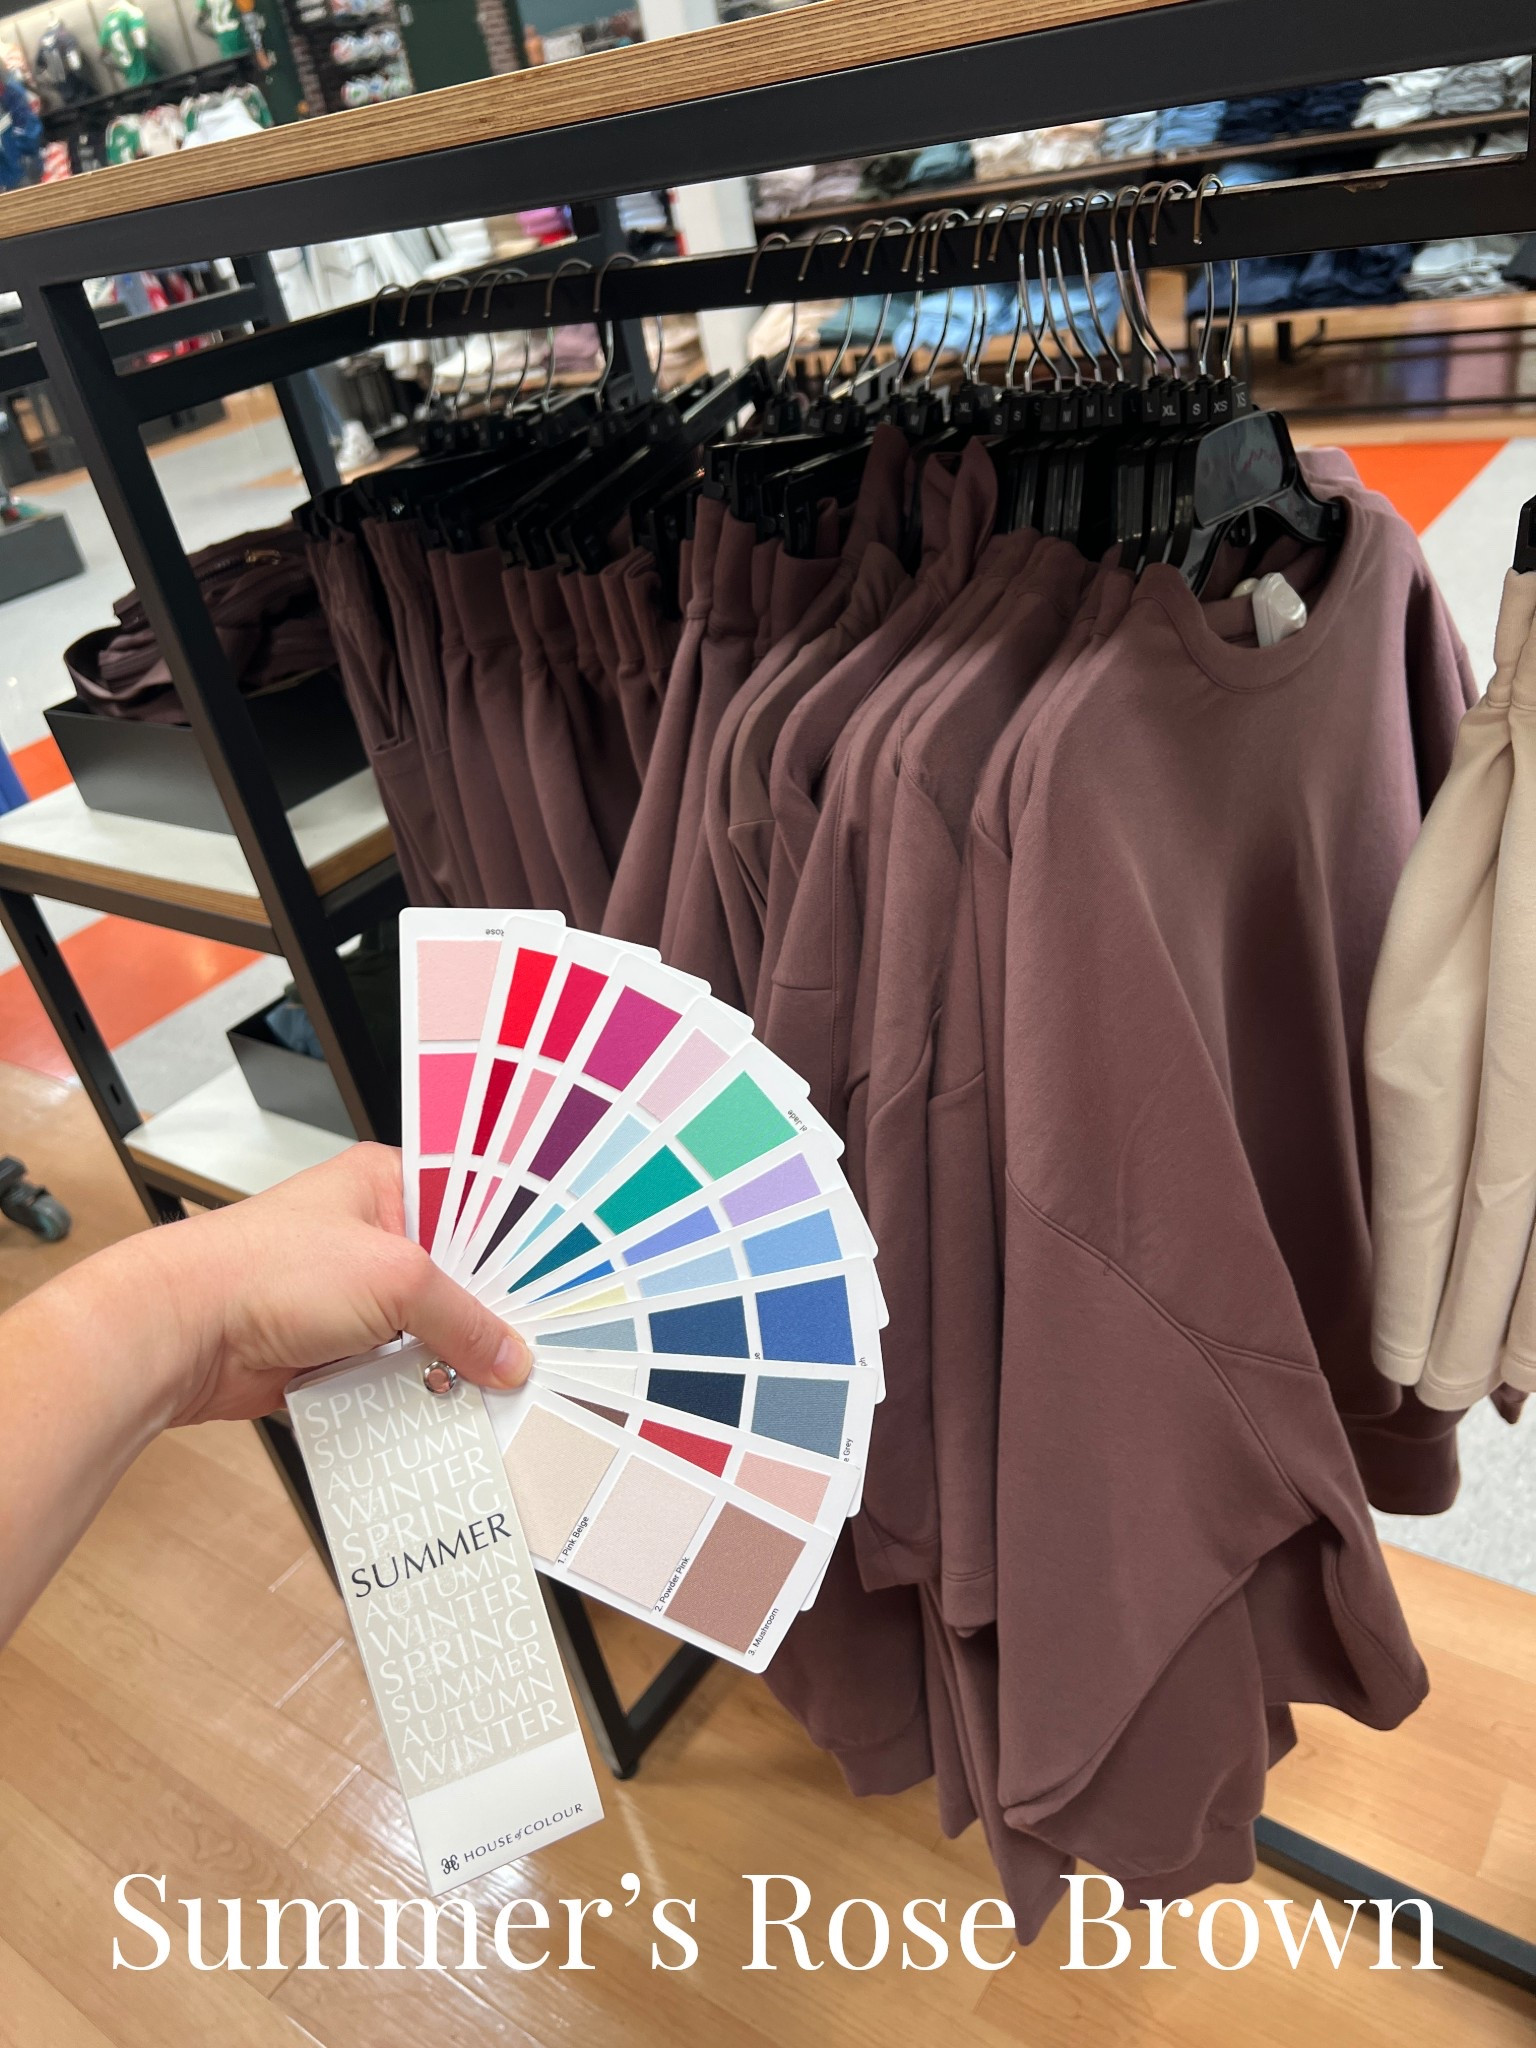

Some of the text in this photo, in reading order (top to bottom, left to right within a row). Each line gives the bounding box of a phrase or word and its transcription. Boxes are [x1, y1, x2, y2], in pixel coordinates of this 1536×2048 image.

[994, 414, 1003, 426] S
[1014, 410, 1022, 421] S
[1063, 410, 1072, 423] M
[1108, 405, 1115, 418] L
[1161, 404, 1177, 417] XL
[1192, 402, 1201, 416] S
[1213, 400, 1229, 414] XS
[787, 1109, 803, 1125] Jade
[305, 1362, 429, 1439] SPRIN
[314, 1386, 474, 1469] SUMMER
[328, 1415, 481, 1500] AUTUMN
[843, 1437, 853, 1456] Grey
[331, 1446, 492, 1530] WINTER
[342, 1478, 502, 1568] SPRING
[562, 1538, 577, 1557] Pink
[572, 1516, 589, 1539] Beige
[351, 1512, 513, 1599] SUMMER
[365, 1542, 519, 1628] AUTUMN
[660, 1574, 680, 1604] Powder
[675, 1556, 690, 1575] Pink
[368, 1573, 529, 1658] WINTER
[752, 1607, 779, 1648] Mushroom
[379, 1605, 538, 1695] SPRING
[391, 1640, 547, 1723] SUMMER
[401, 1668, 555, 1754] AUTUMN
[405, 1698, 565, 1783] WINTER
[464, 1833, 514, 1863] HOUSE
[523, 1803, 584, 1836] COLOUR
